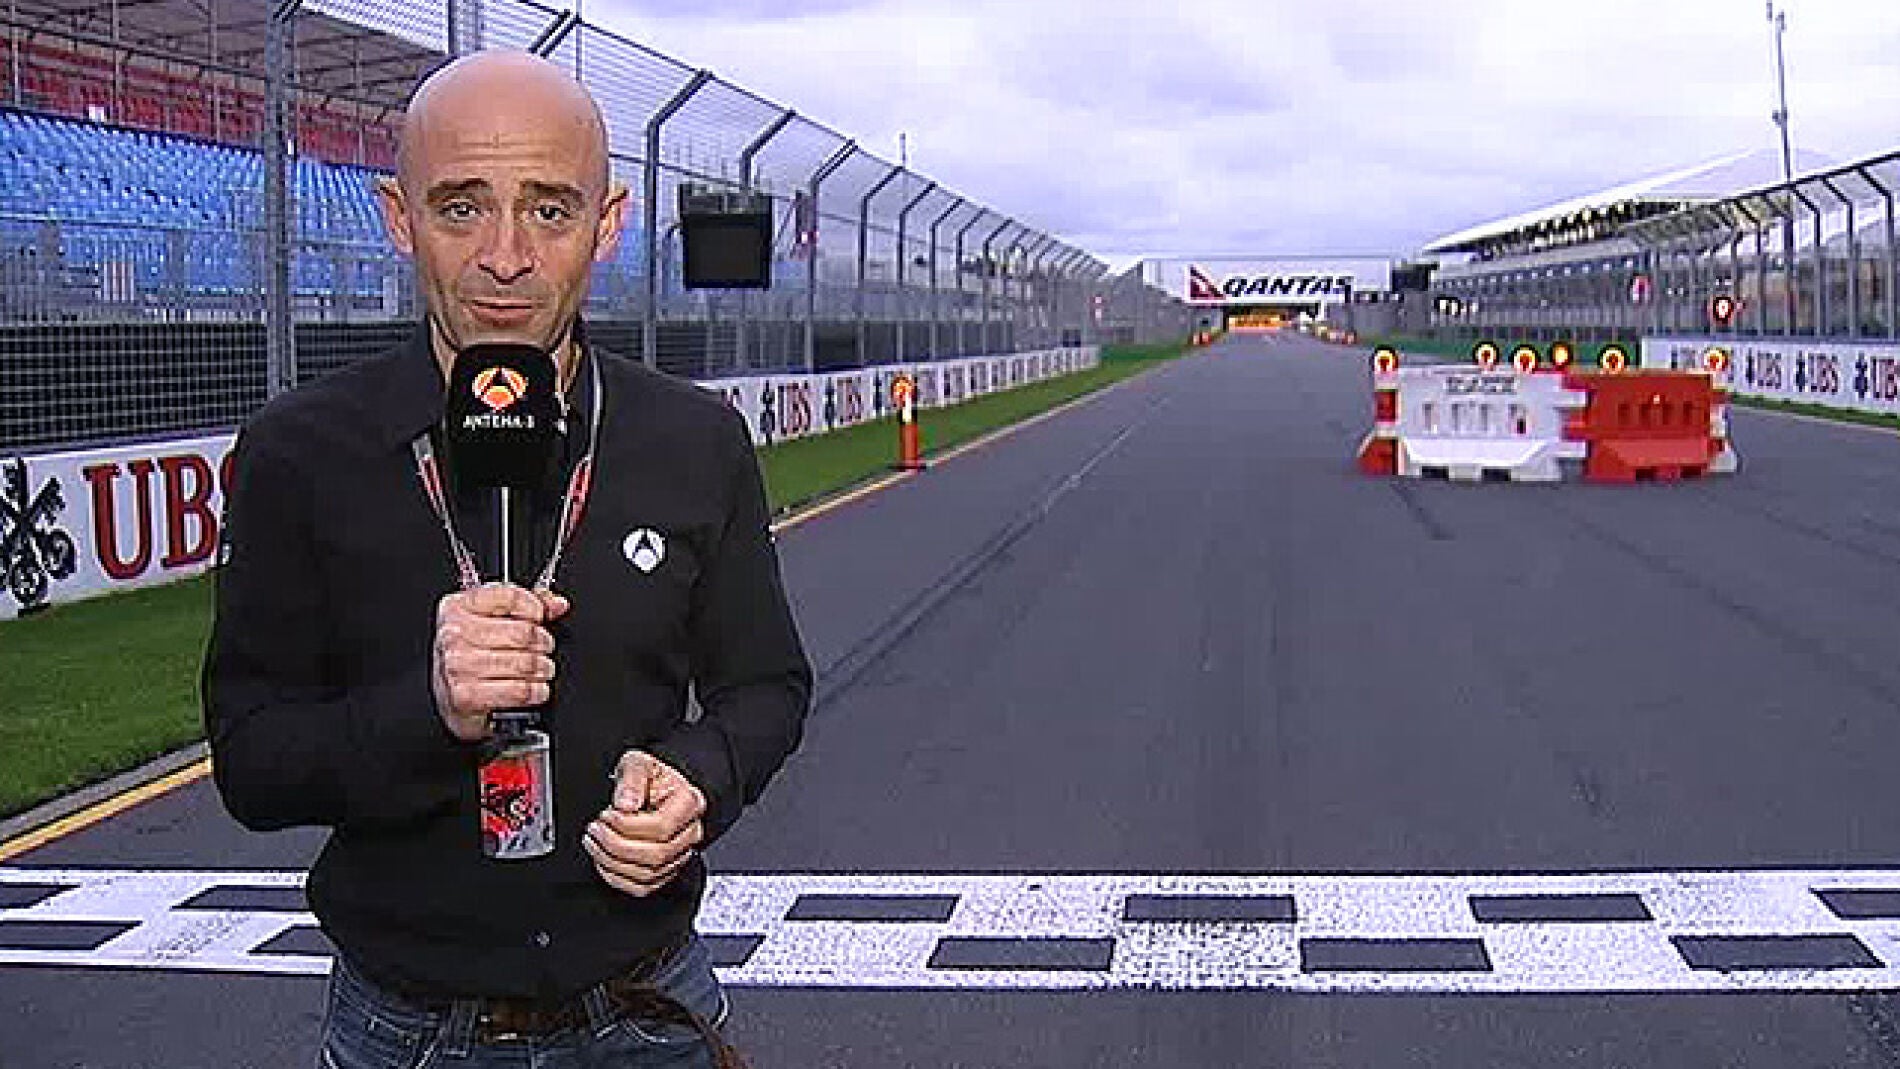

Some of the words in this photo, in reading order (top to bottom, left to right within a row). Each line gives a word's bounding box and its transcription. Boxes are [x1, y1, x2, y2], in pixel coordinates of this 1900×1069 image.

[1223, 275, 1354, 298] QANTAS
[1808, 352, 1839, 393] UBS
[777, 381, 811, 436] UBS
[83, 454, 235, 579] UB
